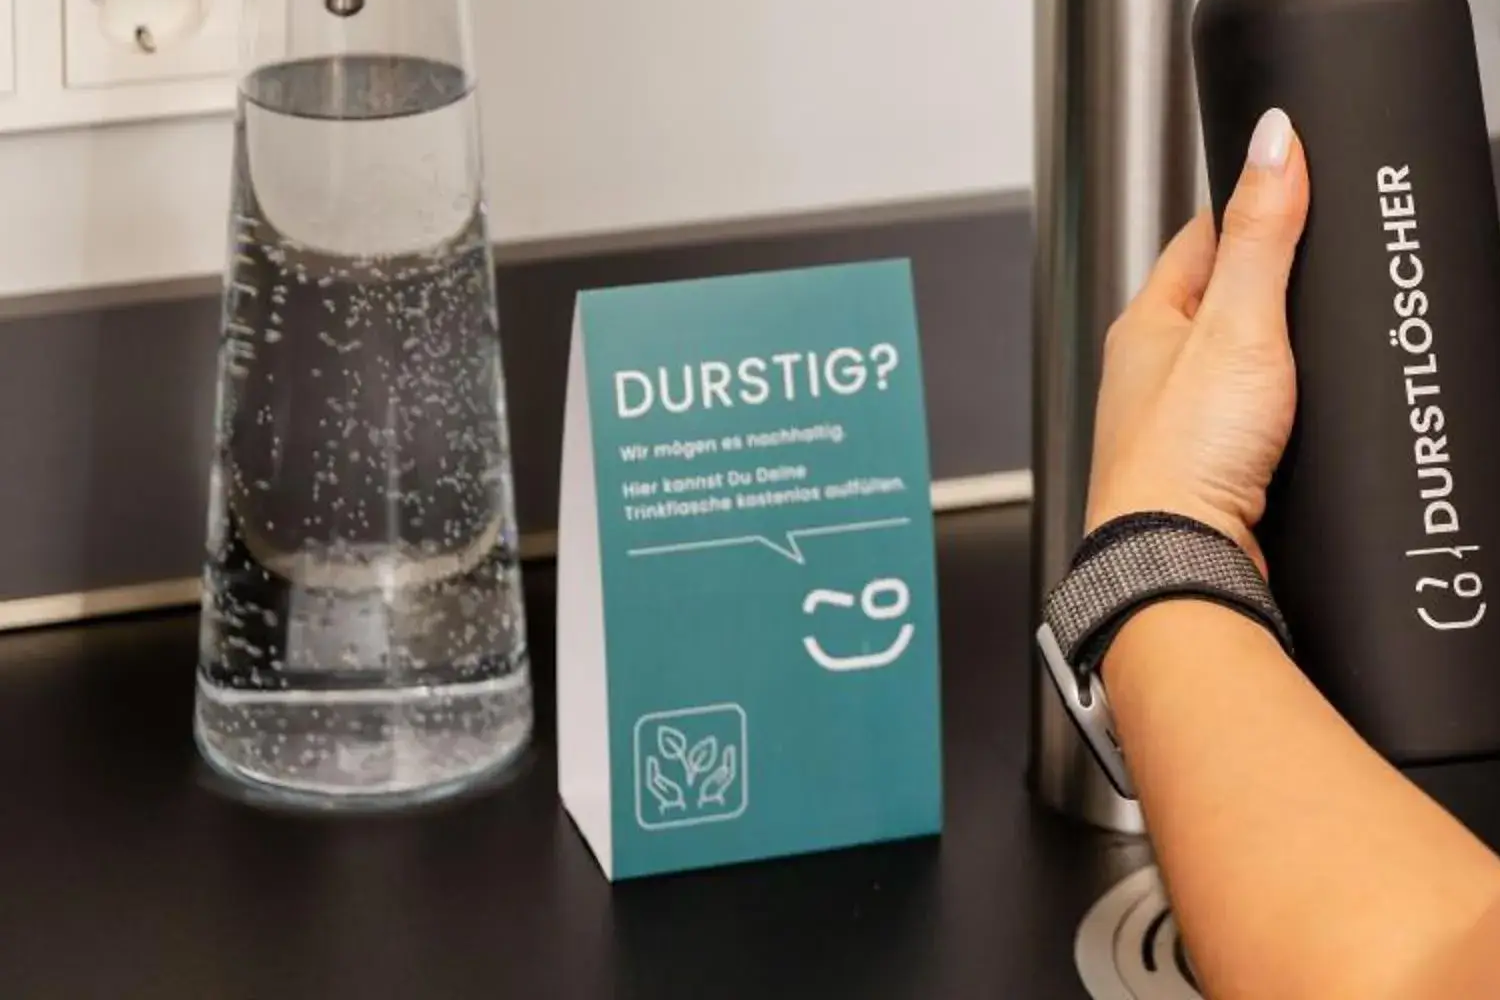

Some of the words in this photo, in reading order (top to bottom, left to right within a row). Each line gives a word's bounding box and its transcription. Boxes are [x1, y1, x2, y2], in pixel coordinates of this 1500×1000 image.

[1377, 164, 1459, 534] DURSTLÖSCHER
[614, 342, 899, 418] DURSTIG?
[619, 444, 648, 462] Wir
[653, 438, 717, 460] mögen
[721, 434, 742, 450] es
[621, 480, 657, 499] Hier
[662, 472, 723, 494] kannst
[727, 469, 752, 487] Du
[756, 464, 806, 483] Deine
[625, 496, 732, 521] Trinkflasche
[735, 486, 821, 509] kostenlos
